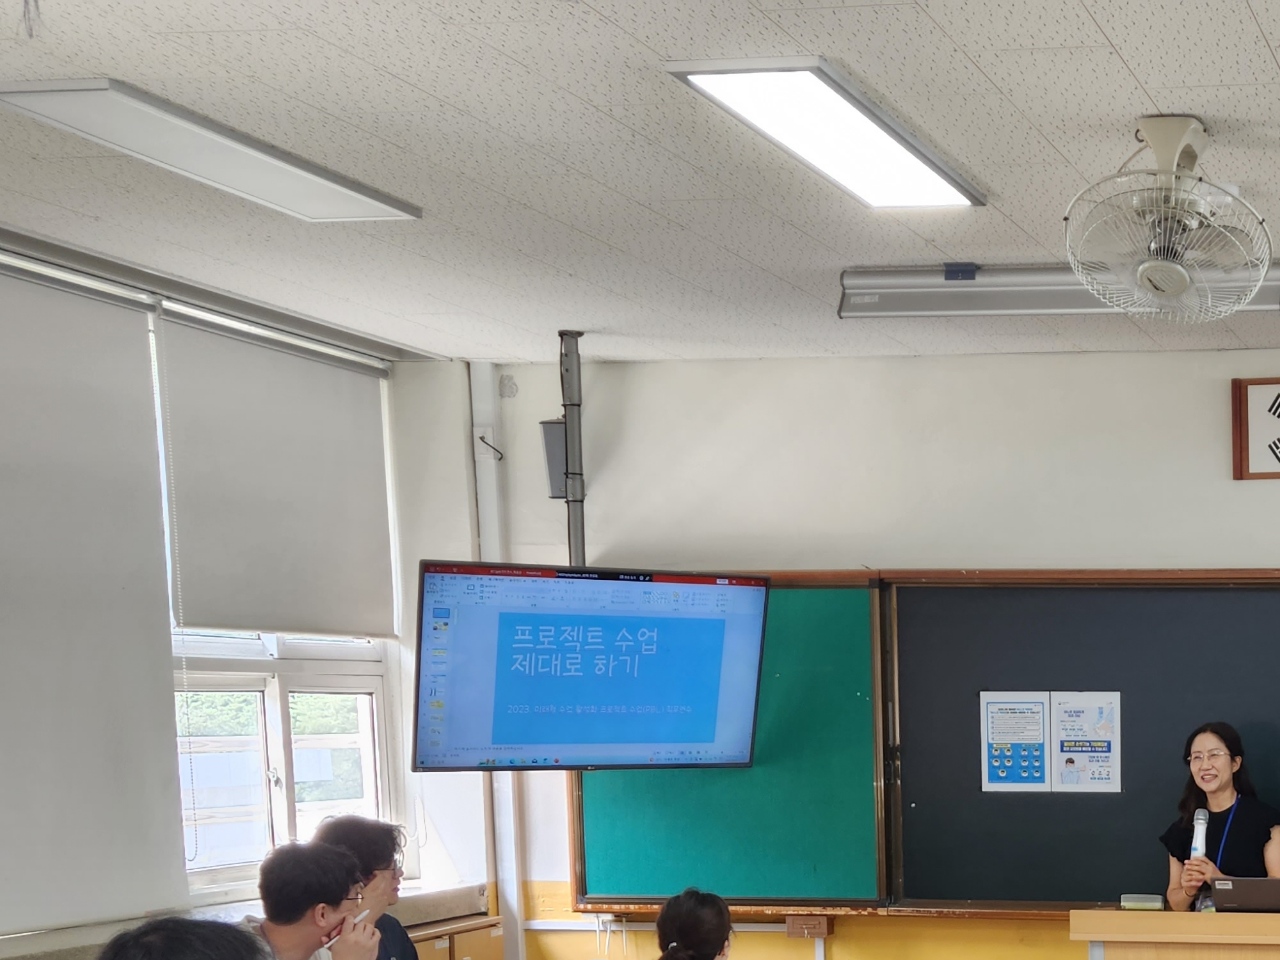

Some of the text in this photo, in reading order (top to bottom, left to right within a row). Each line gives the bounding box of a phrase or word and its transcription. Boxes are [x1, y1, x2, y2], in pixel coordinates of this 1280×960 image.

[512, 626, 658, 655] 프로젝트 수업
[510, 652, 639, 678] 제대로 하기
